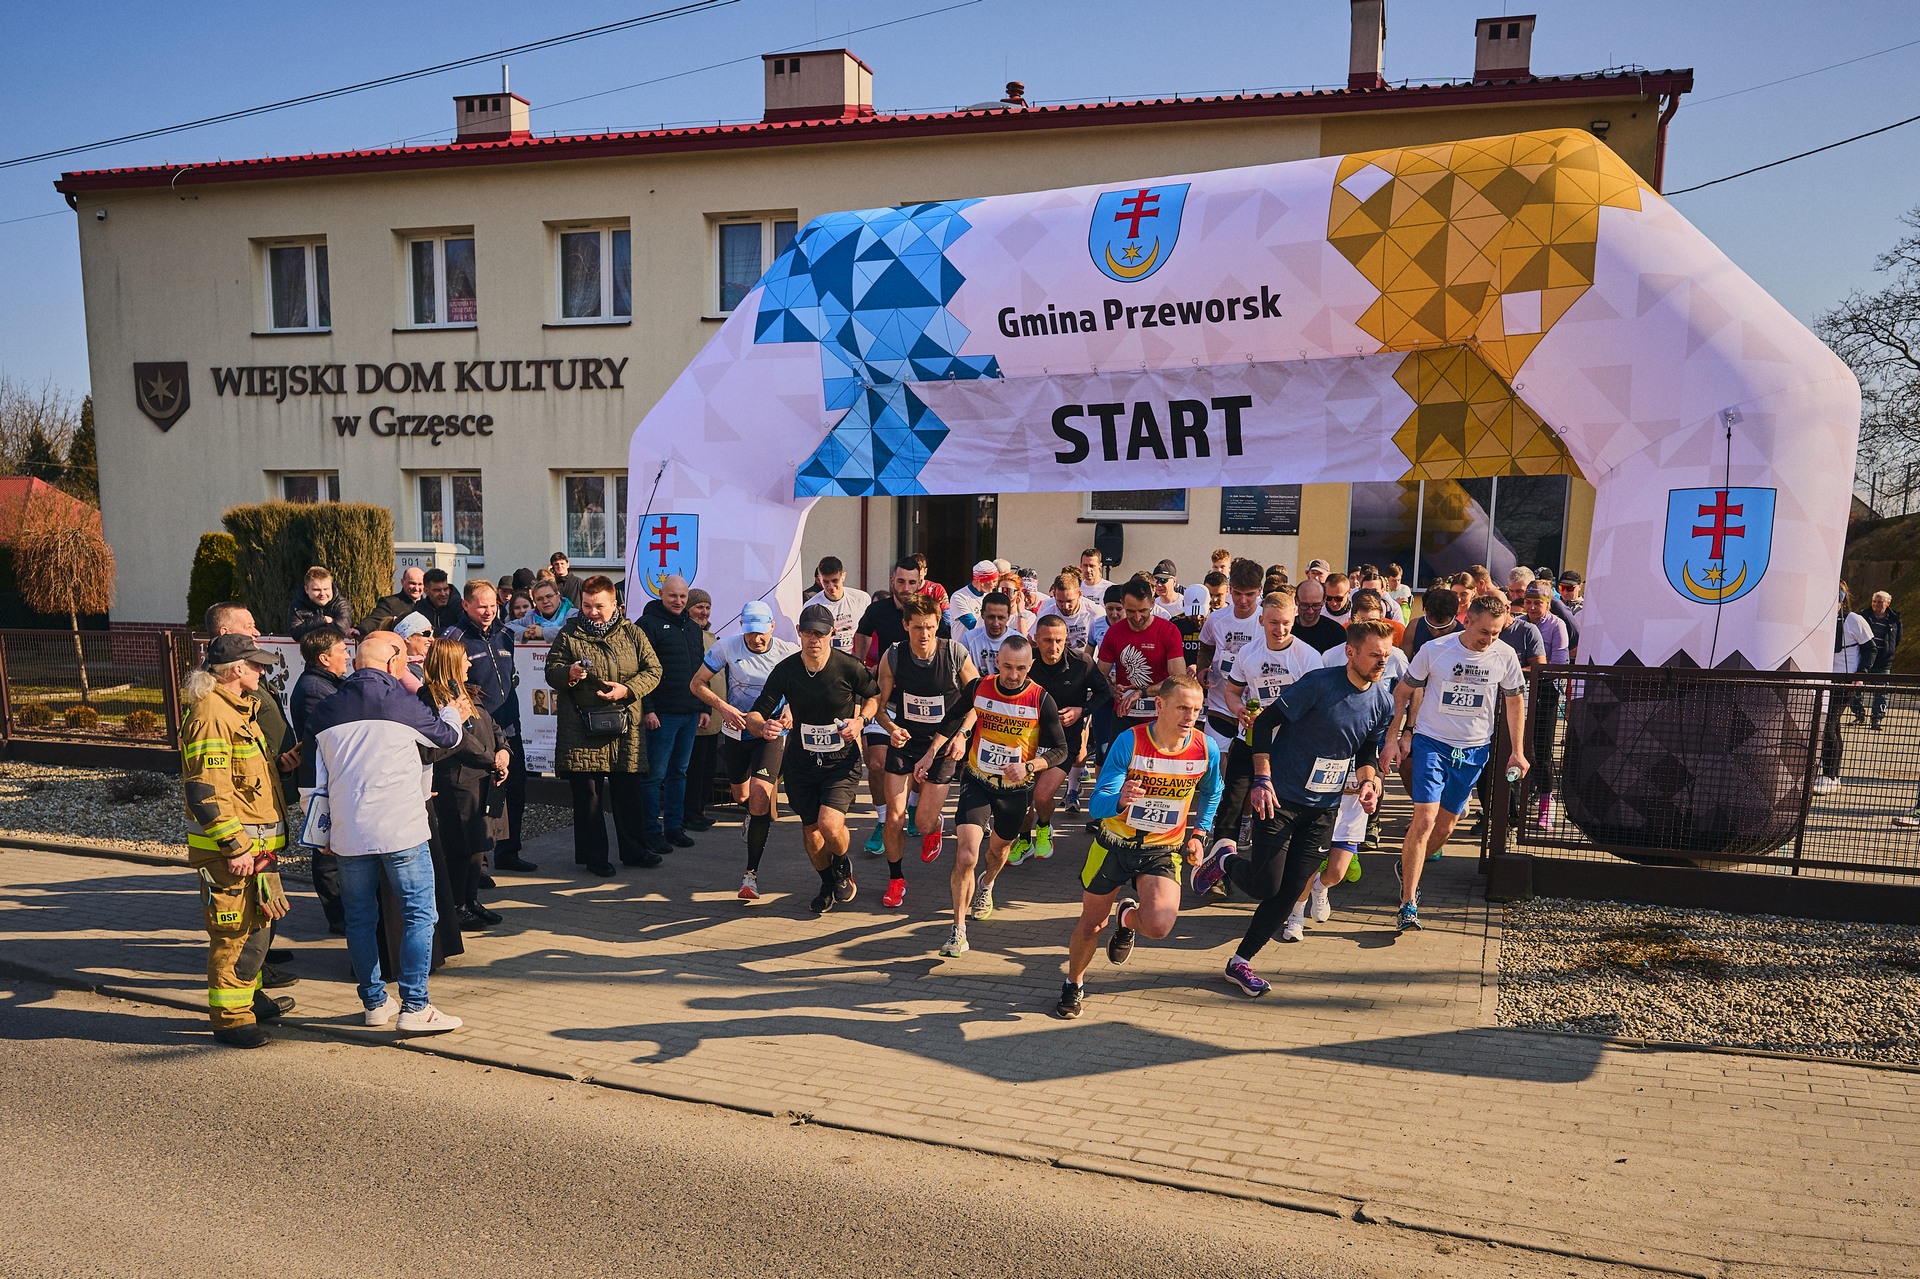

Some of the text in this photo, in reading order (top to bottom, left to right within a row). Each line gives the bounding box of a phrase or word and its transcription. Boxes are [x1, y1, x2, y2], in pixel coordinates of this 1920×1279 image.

[998, 285, 1282, 338] Gmina Przeworsk
[211, 358, 629, 403] WIEJSKI DOM KULTURY
[332, 406, 494, 446] w Grzęsce
[1051, 395, 1253, 464] START
[401, 557, 419, 567] 901
[448, 558, 461, 567] 901
[1268, 685, 1281, 698] 82
[1451, 693, 1475, 707] 238
[917, 705, 930, 716] 18
[982, 720, 1022, 736] BIEGACZ
[811, 733, 832, 745] 120
[207, 757, 226, 766] OSP
[987, 752, 1010, 766] 204
[1322, 771, 1340, 784] 138
[1142, 808, 1168, 824] 231
[220, 912, 238, 922] OSP
